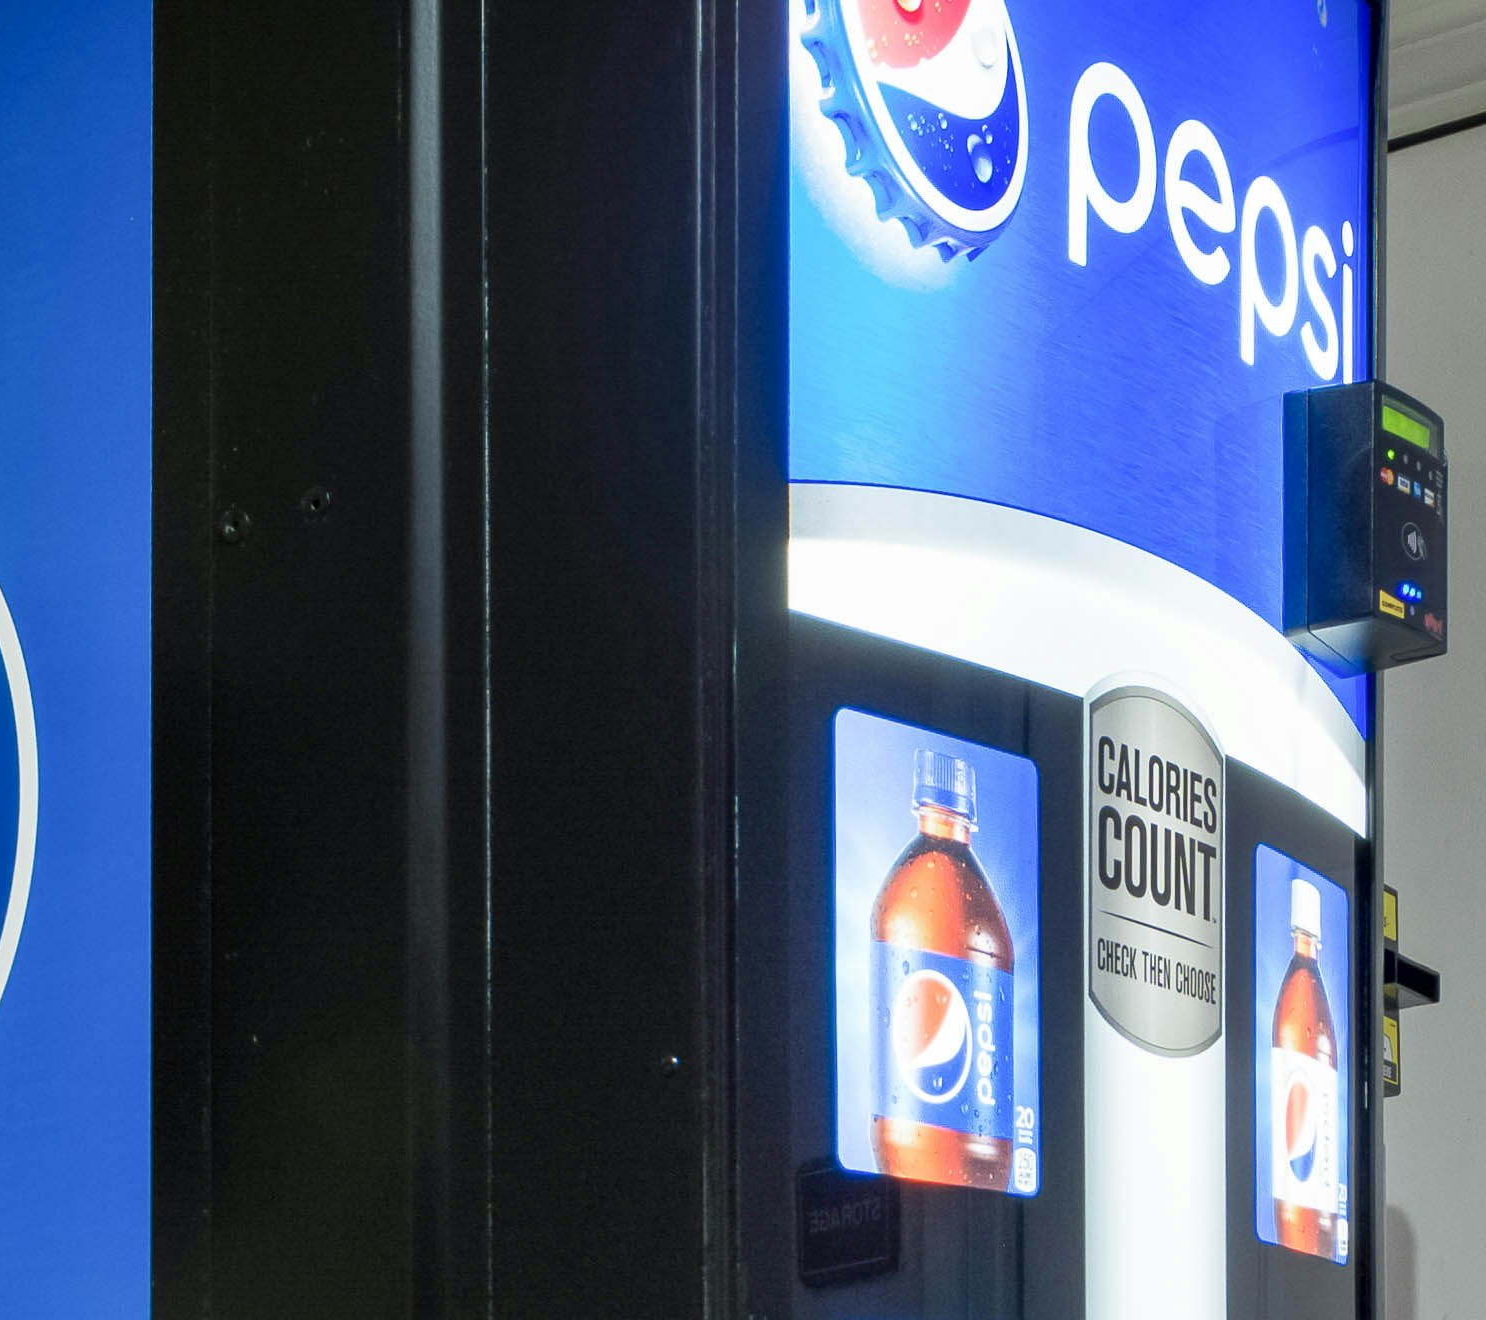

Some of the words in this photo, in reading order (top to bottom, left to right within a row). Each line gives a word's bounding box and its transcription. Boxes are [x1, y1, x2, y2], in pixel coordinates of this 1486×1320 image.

[1068, 60, 1355, 384] pepsi
[1097, 735, 1217, 834] CALORIES
[1097, 805, 1217, 922] COUNT
[1097, 937, 1137, 980] CHECK
[1141, 949, 1171, 989] THEN
[1175, 958, 1217, 1006] CHOOSE
[975, 989, 1006, 1106] pepsi
[1015, 1104, 1035, 1130] 20
